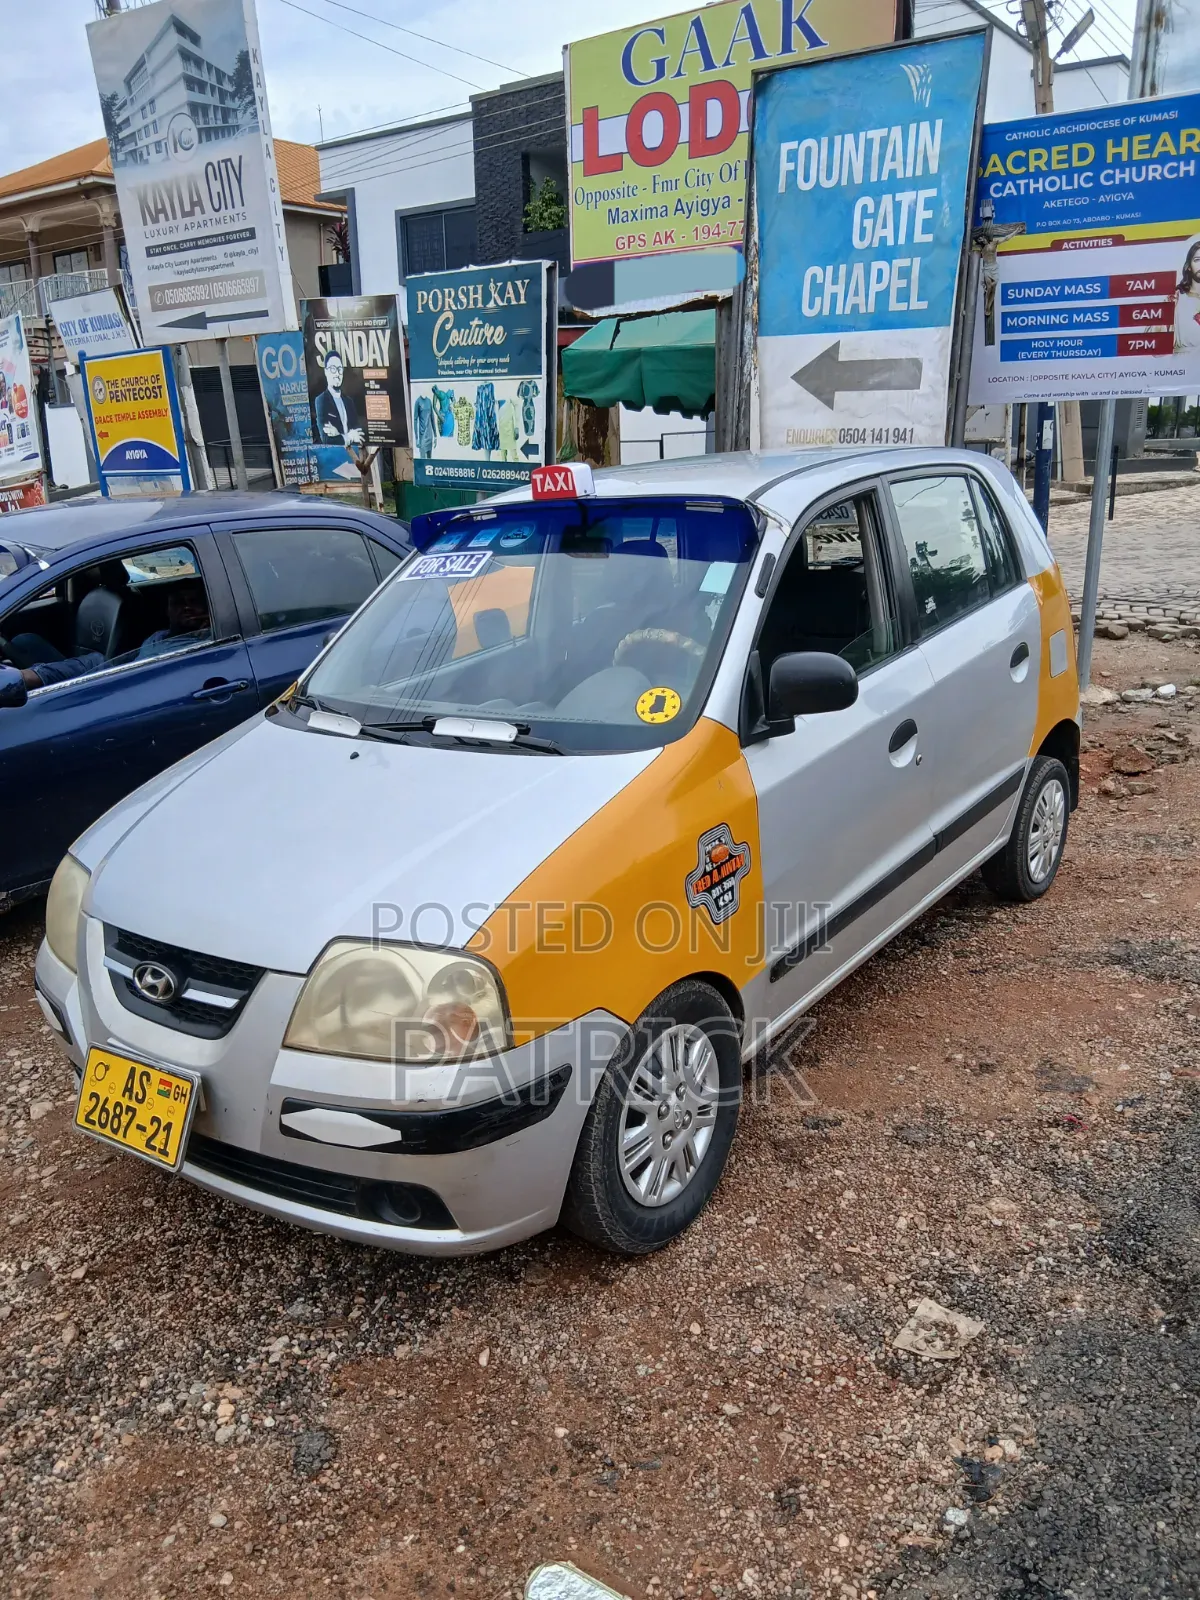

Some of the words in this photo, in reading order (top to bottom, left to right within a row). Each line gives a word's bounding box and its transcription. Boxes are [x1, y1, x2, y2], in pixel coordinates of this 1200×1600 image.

[620, 0, 829, 88] GAAK
[582, 79, 754, 178] LOD
[1005, 128, 1051, 142] CATHOLIC
[1052, 119, 1121, 136] ARCHDIOCESE
[1123, 117, 1137, 126] OF
[1139, 110, 1179, 124] KUMASI
[778, 118, 943, 195] FOUNTAIN
[574, 180, 639, 211] Oppossite
[652, 174, 681, 194] Fmr
[684, 168, 715, 193] City
[719, 159, 741, 184] Of
[989, 171, 1094, 199] CATHOLIC
[1099, 159, 1196, 186] CHURCH
[137, 173, 206, 227] KAYLA
[204, 155, 245, 213] CITY
[1042, 197, 1090, 209] AKETEGO
[1098, 191, 1135, 204] AYIGYA
[607, 203, 669, 226] Maxima
[673, 195, 732, 220] Ayigya
[852, 188, 938, 250] GATE
[143, 224, 180, 239] LUXURY
[184, 211, 248, 233] APARTMENTS
[1048, 219, 1061, 227] BOX
[197, 235, 225, 247] MEMORIES
[615, 233, 647, 251] GPS
[652, 228, 676, 247] AK
[1062, 237, 1113, 250] ACTIVITIES
[190, 254, 217, 265] Apartments
[801, 257, 929, 319] CHAPEL
[1007, 286, 1061, 299] SUNDAY
[1064, 283, 1101, 296] MASS
[1126, 279, 1156, 291] 7AM
[416, 283, 484, 314] PORSH
[486, 278, 530, 308] KAY
[1006, 314, 1071, 327] MORNING
[1072, 311, 1110, 324] MASS
[1132, 308, 1162, 320] 6AM
[59, 319, 78, 337] CITY
[78, 317, 89, 334] OF
[88, 312, 124, 333] KUMASI
[432, 310, 507, 358] Couture
[64, 333, 111, 347] INTERNATIONAL
[314, 329, 391, 368] SUNDAY
[1031, 340, 1054, 349] HOLY
[1057, 339, 1083, 348] HOUR
[1128, 340, 1156, 350] 7PM
[1018, 351, 1049, 361] (EVERY
[1051, 348, 1102, 358] THURSDAY)
[106, 379, 119, 390] THE
[120, 376, 149, 387] CHURCH
[150, 374, 160, 384] OF
[988, 375, 1025, 383] LOCATION
[1154, 369, 1186, 377] KUMASI
[109, 385, 163, 403] PENTECOST
[1053, 390, 1075, 398] worship
[94, 414, 114, 425] GRACE
[114, 412, 137, 423] TEMPLE
[137, 407, 169, 420] ASSEMBLY
[838, 427, 867, 445] 0504
[870, 427, 889, 445] 141
[892, 427, 914, 445] 941
[125, 449, 148, 460] AYIGYA
[434, 466, 476, 479] 0241858816
[482, 468, 530, 481] 0262889402
[532, 471, 575, 493] TAXI
[412, 557, 444, 575] FOR
[440, 554, 483, 572] SALE
[692, 875, 711, 895] FRED
[122, 1066, 151, 1104] AS
[173, 1084, 189, 1104] GH
[84, 1092, 173, 1158] 2687-21
